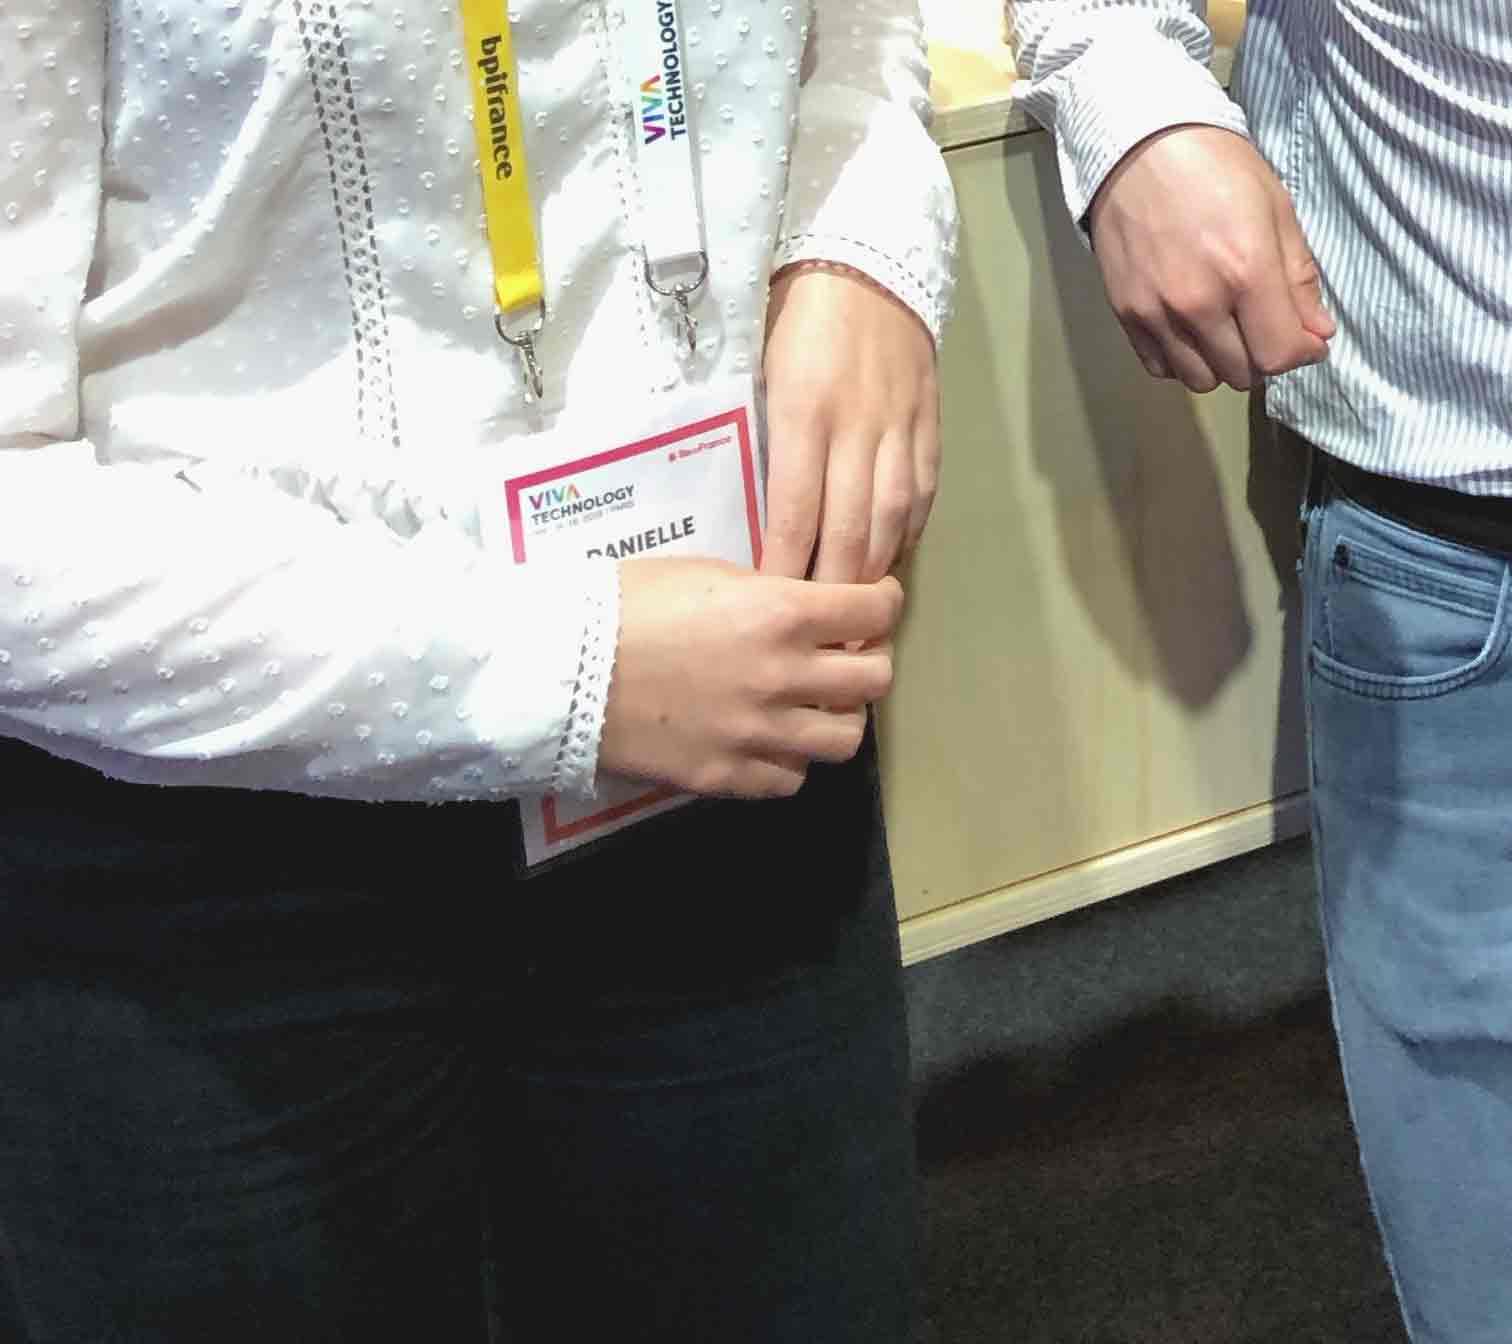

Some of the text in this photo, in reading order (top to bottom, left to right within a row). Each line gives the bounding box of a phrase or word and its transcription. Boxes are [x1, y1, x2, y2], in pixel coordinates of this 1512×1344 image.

[656, 0, 685, 141] TECHNOLOGY
[479, 34, 512, 181] bpifrance
[643, 74, 667, 144] VIVA
[529, 484, 580, 509] VIVA
[531, 484, 635, 526] TECHNOLOGY
